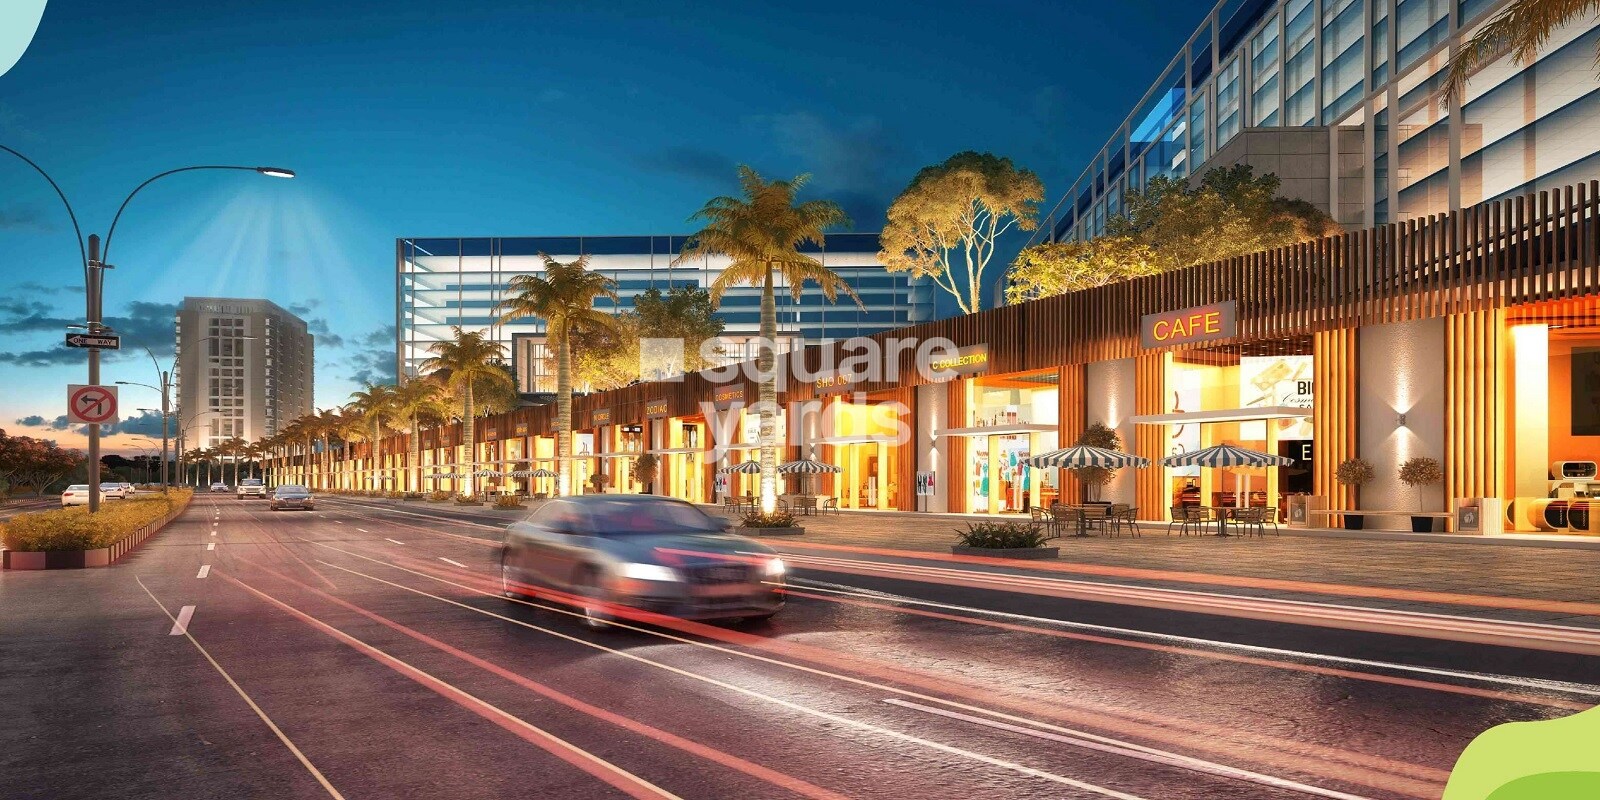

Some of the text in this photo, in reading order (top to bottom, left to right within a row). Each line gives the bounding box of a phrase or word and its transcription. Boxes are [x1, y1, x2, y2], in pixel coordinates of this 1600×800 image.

[1153, 312, 1220, 341] CAFE
[939, 353, 987, 368] COLLECTION
[816, 376, 834, 389] SHO
[1297, 381, 1314, 395] BI
[715, 390, 744, 402] COSMETICS
[646, 404, 667, 415] ZODIAC
